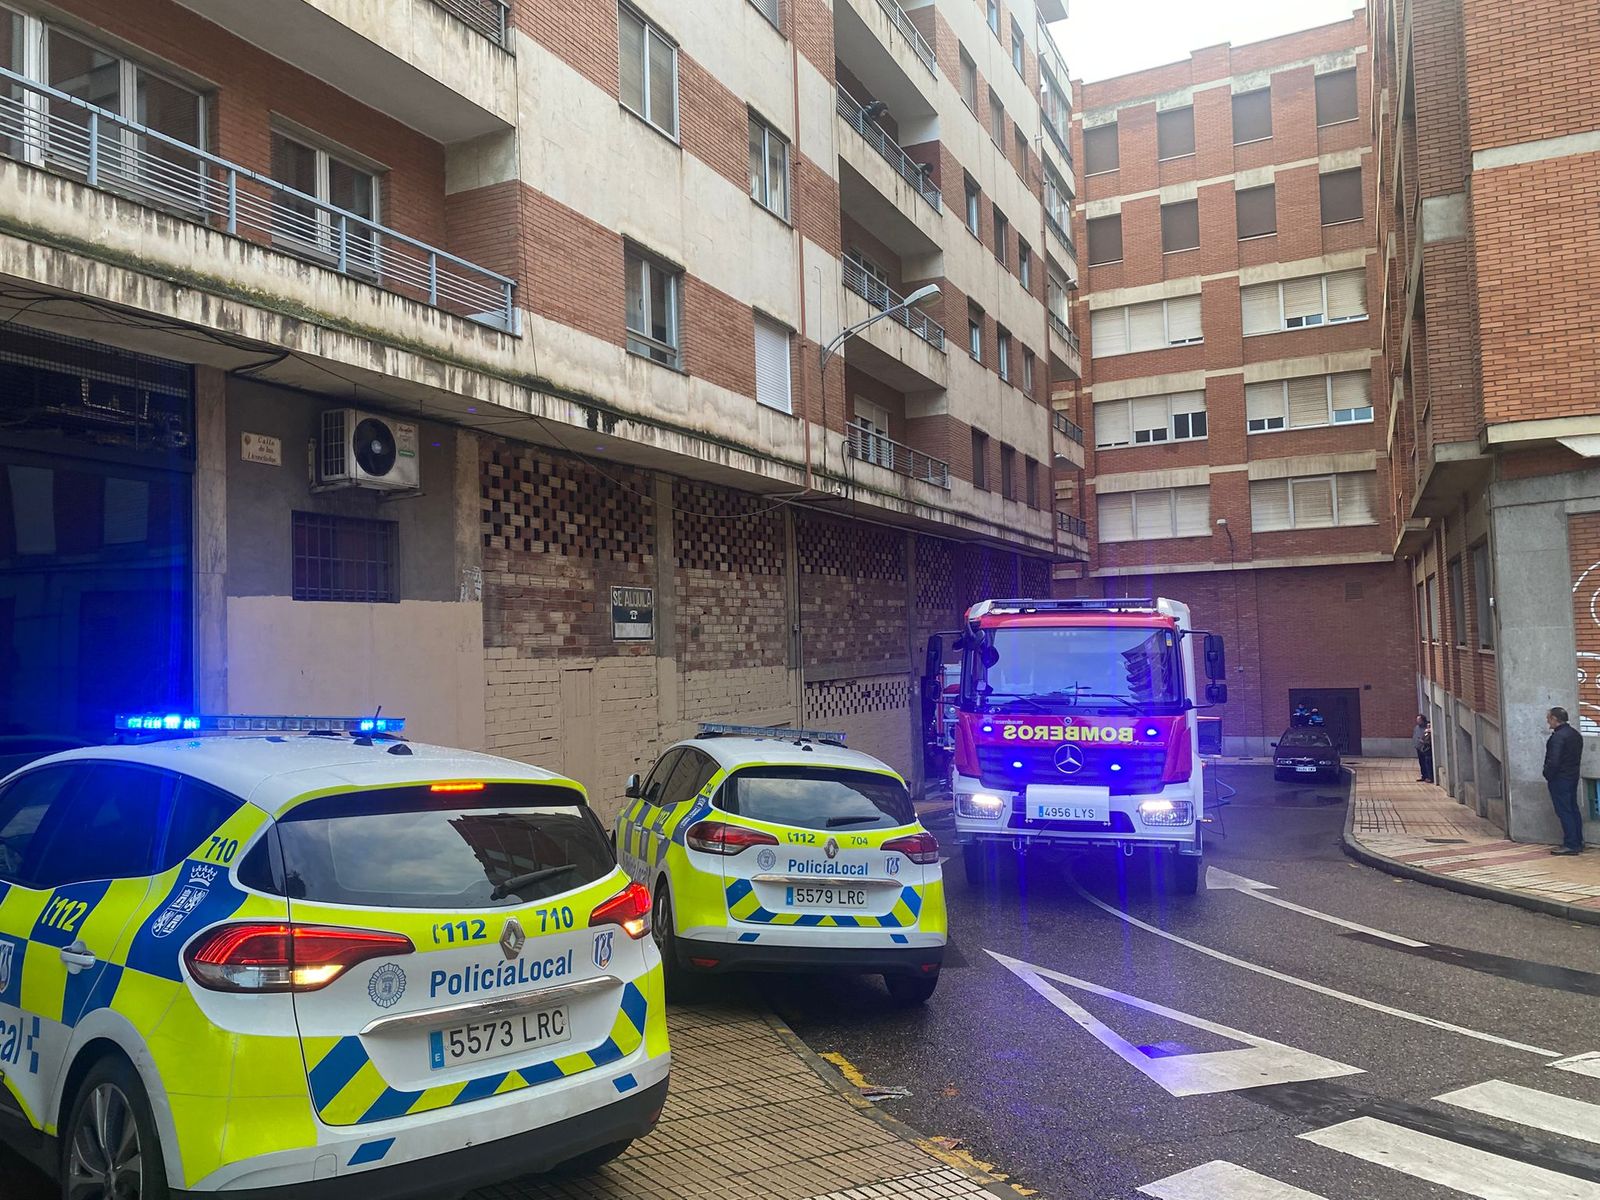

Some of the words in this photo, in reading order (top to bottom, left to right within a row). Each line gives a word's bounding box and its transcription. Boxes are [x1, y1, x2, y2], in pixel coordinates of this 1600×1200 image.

[258, 437, 275, 446] Calle
[612, 590, 623, 606] SE
[624, 590, 652, 608] ALQUILA
[1044, 808, 1071, 818] 4956
[1074, 809, 1094, 818] LYS
[793, 832, 816, 844] 112
[850, 836, 868, 845] 704
[204, 836, 239, 863] 710
[788, 859, 869, 876] PolicíaLocal
[796, 888, 833, 904] 5579
[837, 890, 865, 905] LRC
[50, 897, 88, 932] 112
[536, 906, 574, 932] 710
[441, 919, 487, 944] 112
[430, 949, 573, 998] PolicíaLocal
[449, 1020, 514, 1059] 5573
[522, 1009, 565, 1044] LRC
[434, 1053, 442, 1063] E
